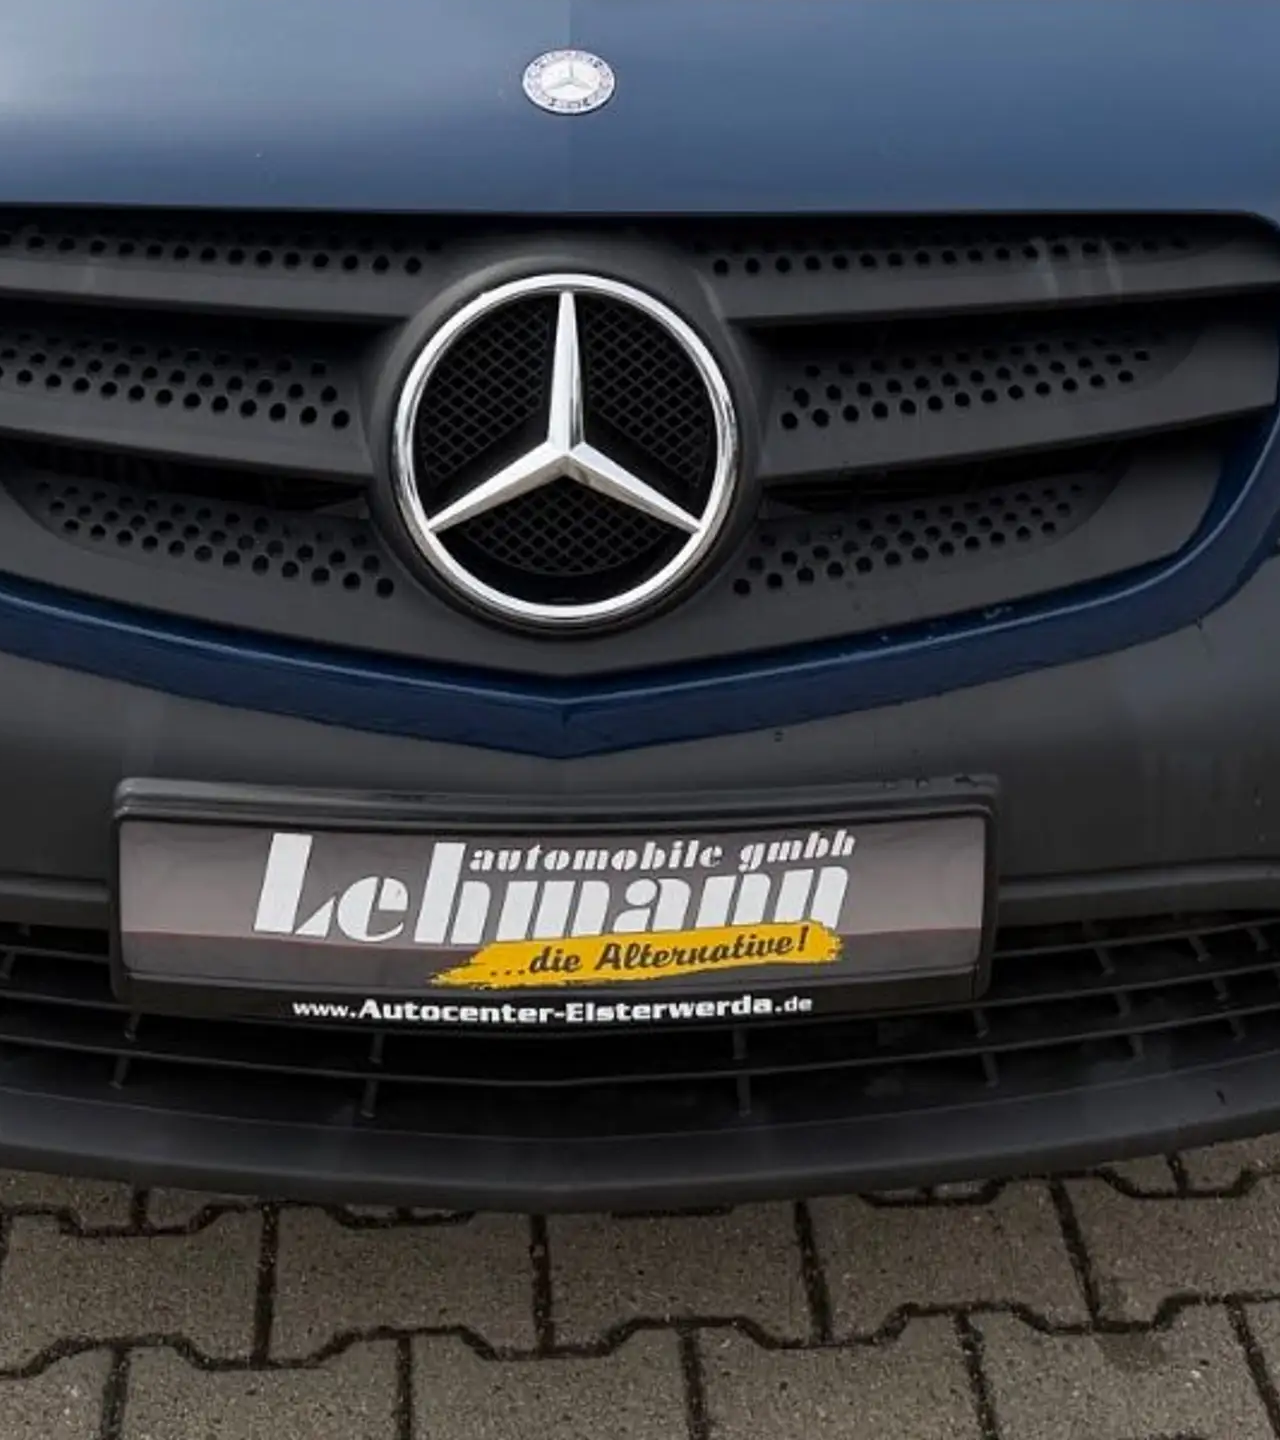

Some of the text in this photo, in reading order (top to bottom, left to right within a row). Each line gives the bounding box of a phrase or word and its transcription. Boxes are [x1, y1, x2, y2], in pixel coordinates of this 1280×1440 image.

[469, 829, 856, 873] automobile gmbh
[253, 832, 850, 945] Lehmann
[594, 924, 811, 972] Alternative!
[292, 994, 814, 1024] www.Autocenter-Elsterwerda.de
